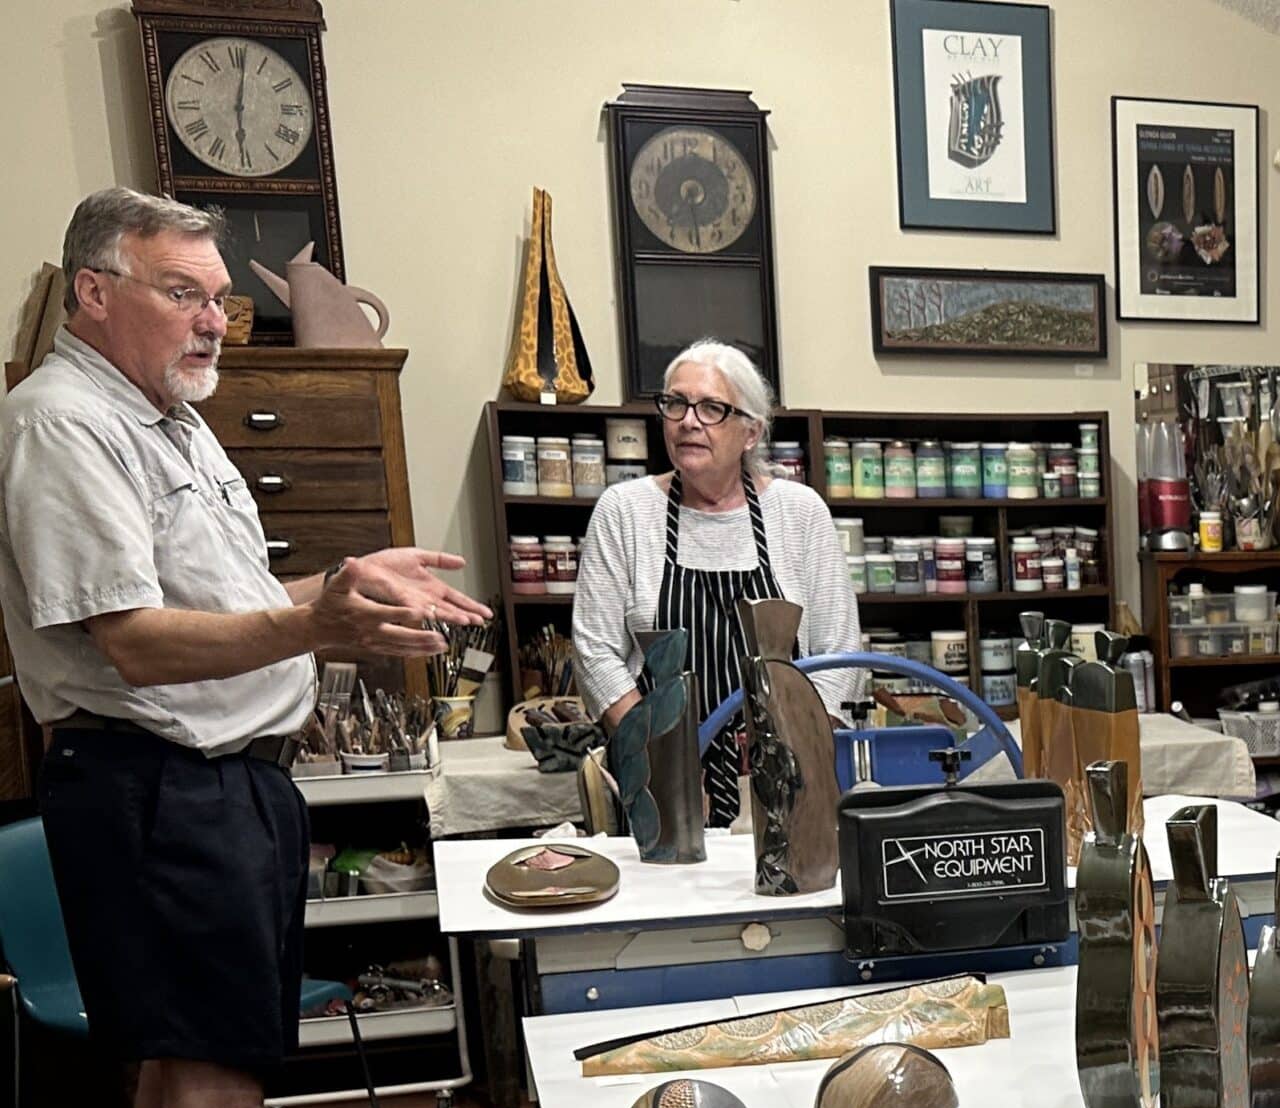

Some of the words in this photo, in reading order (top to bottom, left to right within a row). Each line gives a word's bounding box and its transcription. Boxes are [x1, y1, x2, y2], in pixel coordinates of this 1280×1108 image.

[943, 34, 1003, 58] CLAY
[965, 176, 992, 193] ART
[924, 838, 985, 859] NORTH
[991, 835, 1033, 854] STAR
[933, 854, 1035, 878] EQUIPMENT
